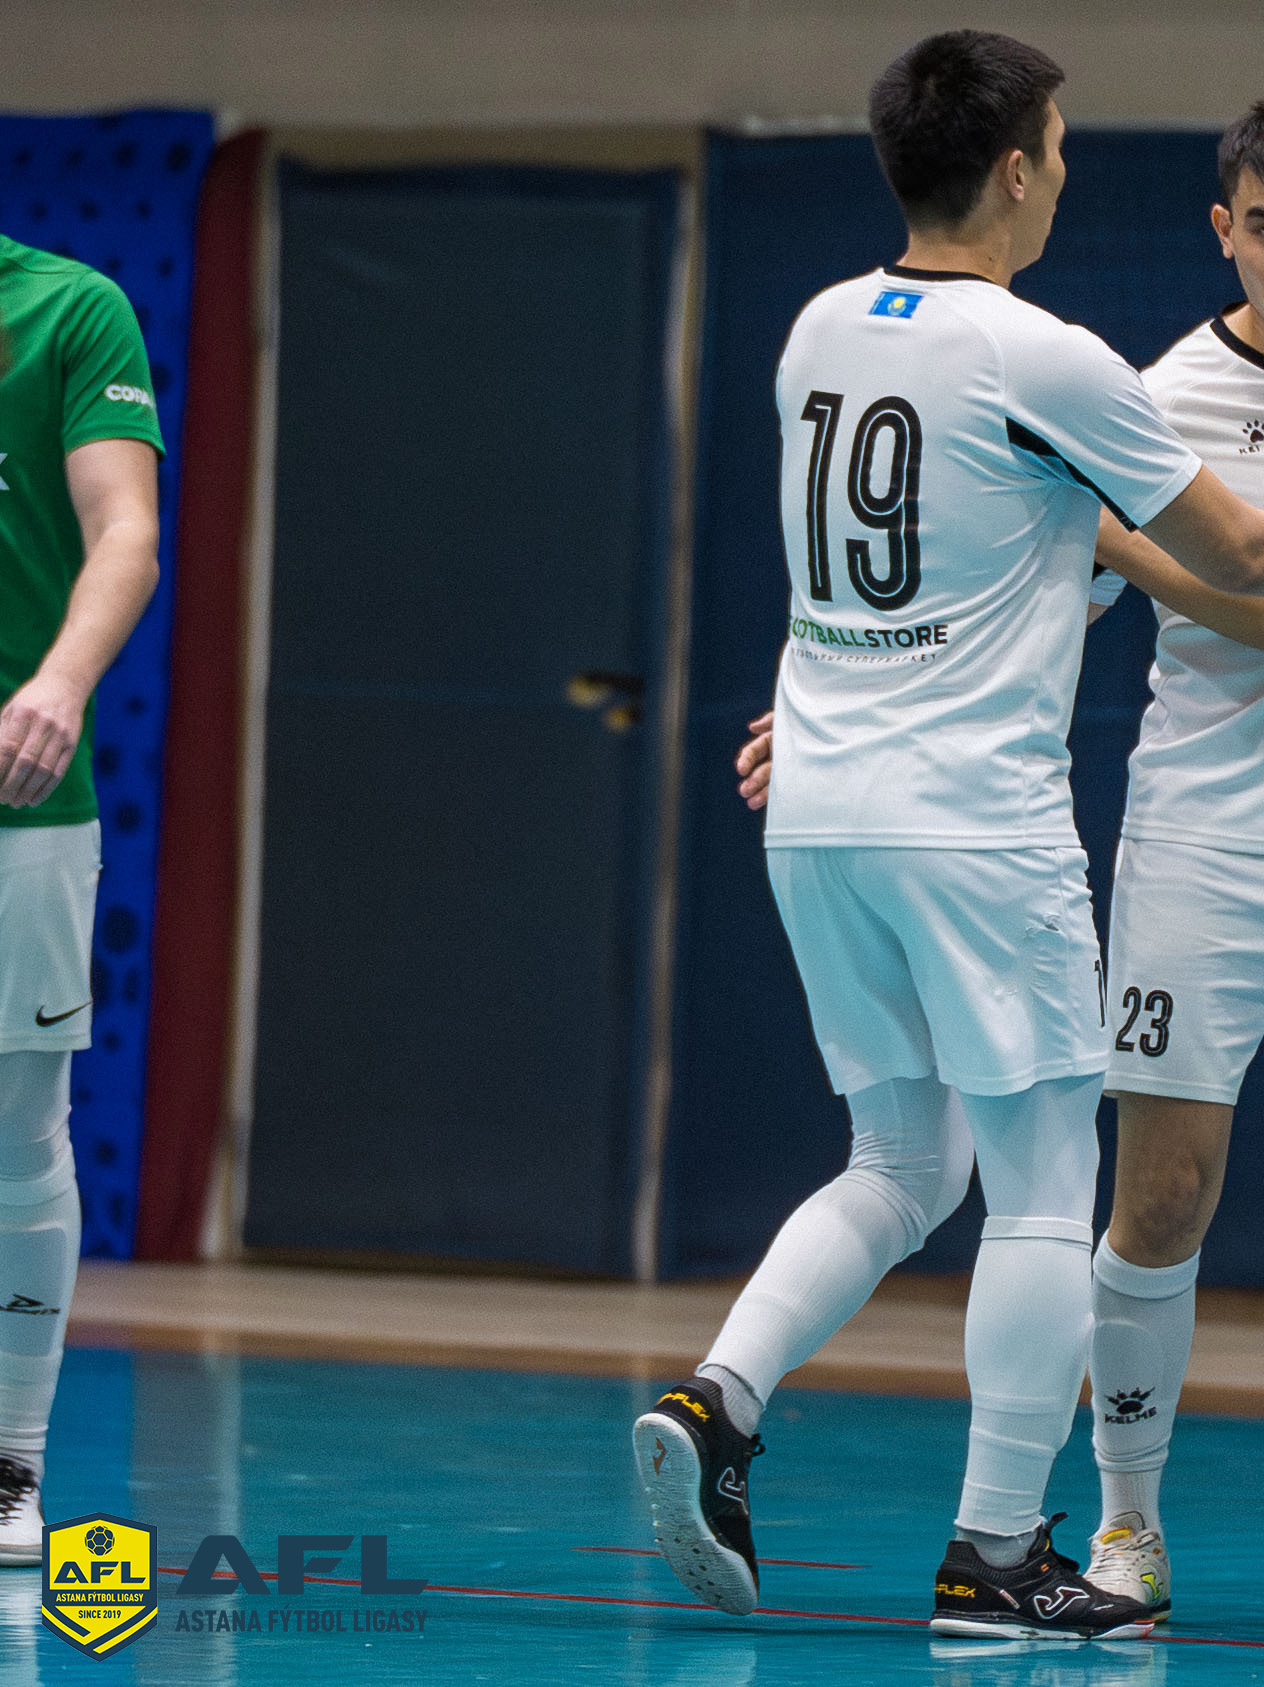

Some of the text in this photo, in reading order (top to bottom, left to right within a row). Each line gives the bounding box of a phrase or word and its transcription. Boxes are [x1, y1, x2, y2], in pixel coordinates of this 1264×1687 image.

[800, 390, 922, 611] 19
[1115, 986, 1174, 1057] 23
[1104, 1406, 1157, 1425] KELME
